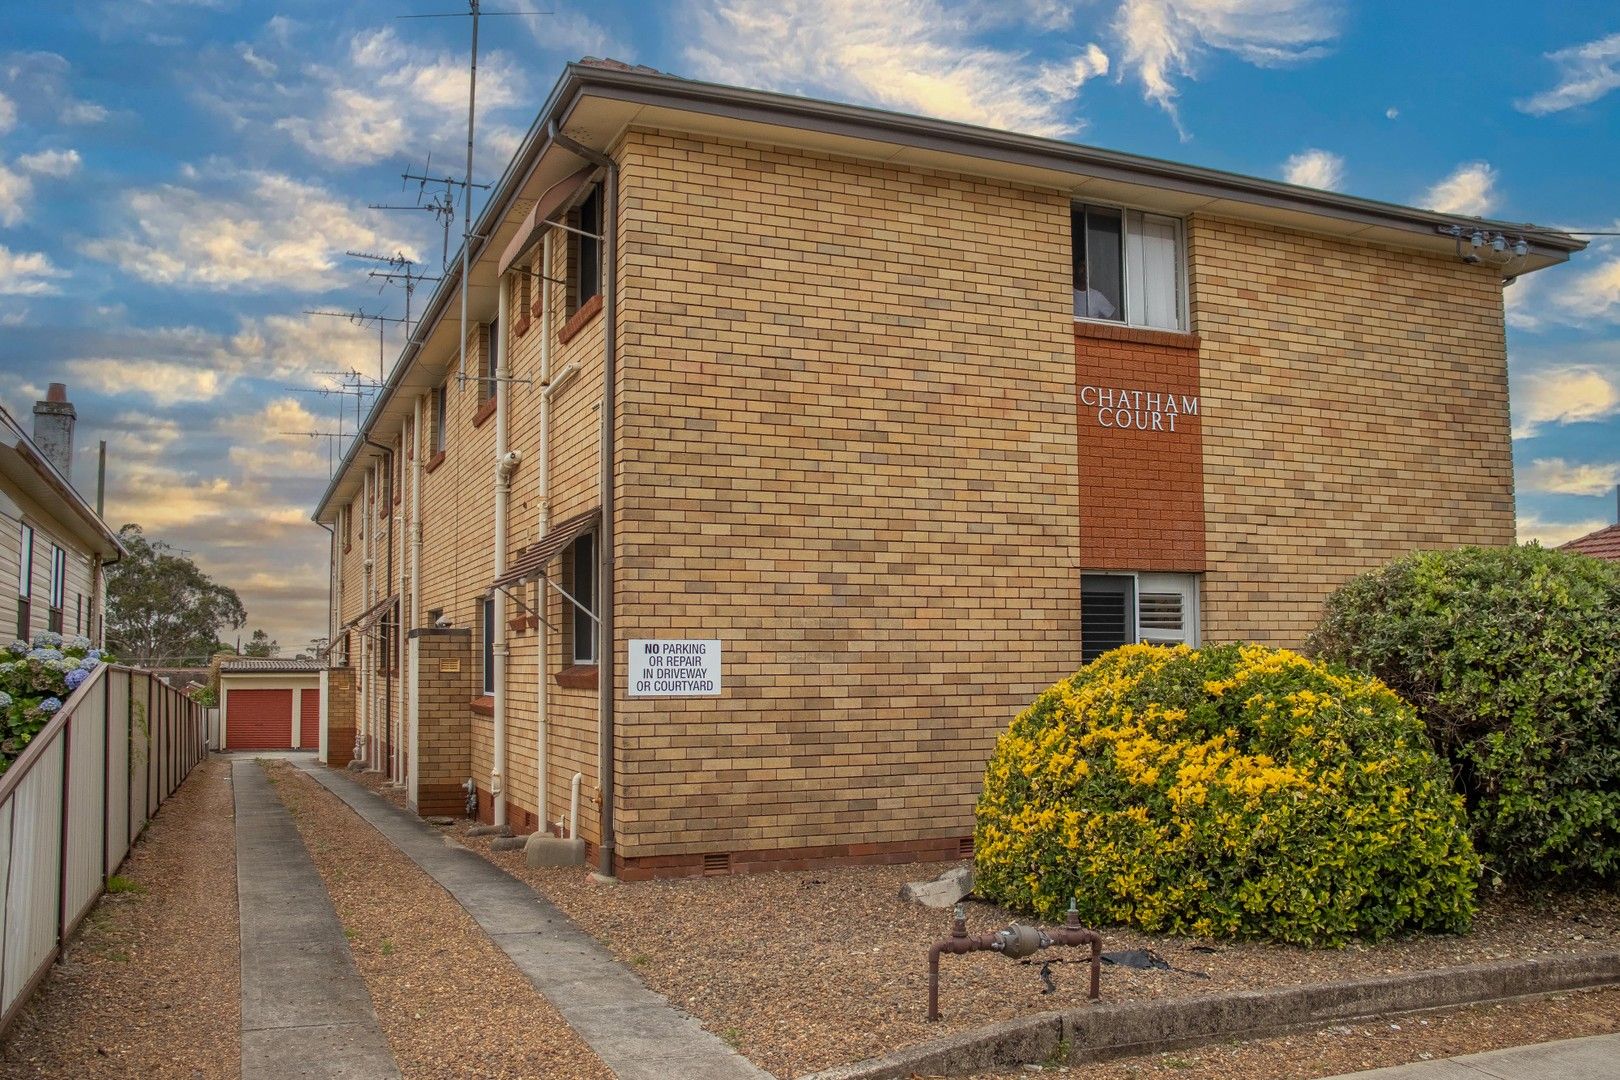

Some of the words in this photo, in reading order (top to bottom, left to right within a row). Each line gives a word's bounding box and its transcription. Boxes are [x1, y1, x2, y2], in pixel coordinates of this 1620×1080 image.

[1081, 386, 1198, 415] CHATHAM
[1098, 407, 1178, 432] COURT
[644, 643, 660, 654] NO
[662, 643, 706, 654] PARKING
[649, 656, 663, 666] OR
[666, 656, 702, 666] REPAIR
[643, 668, 653, 679] IN
[656, 668, 708, 679] DRIVEWAY
[636, 680, 651, 691] OR
[654, 680, 714, 691] COURTYARD
